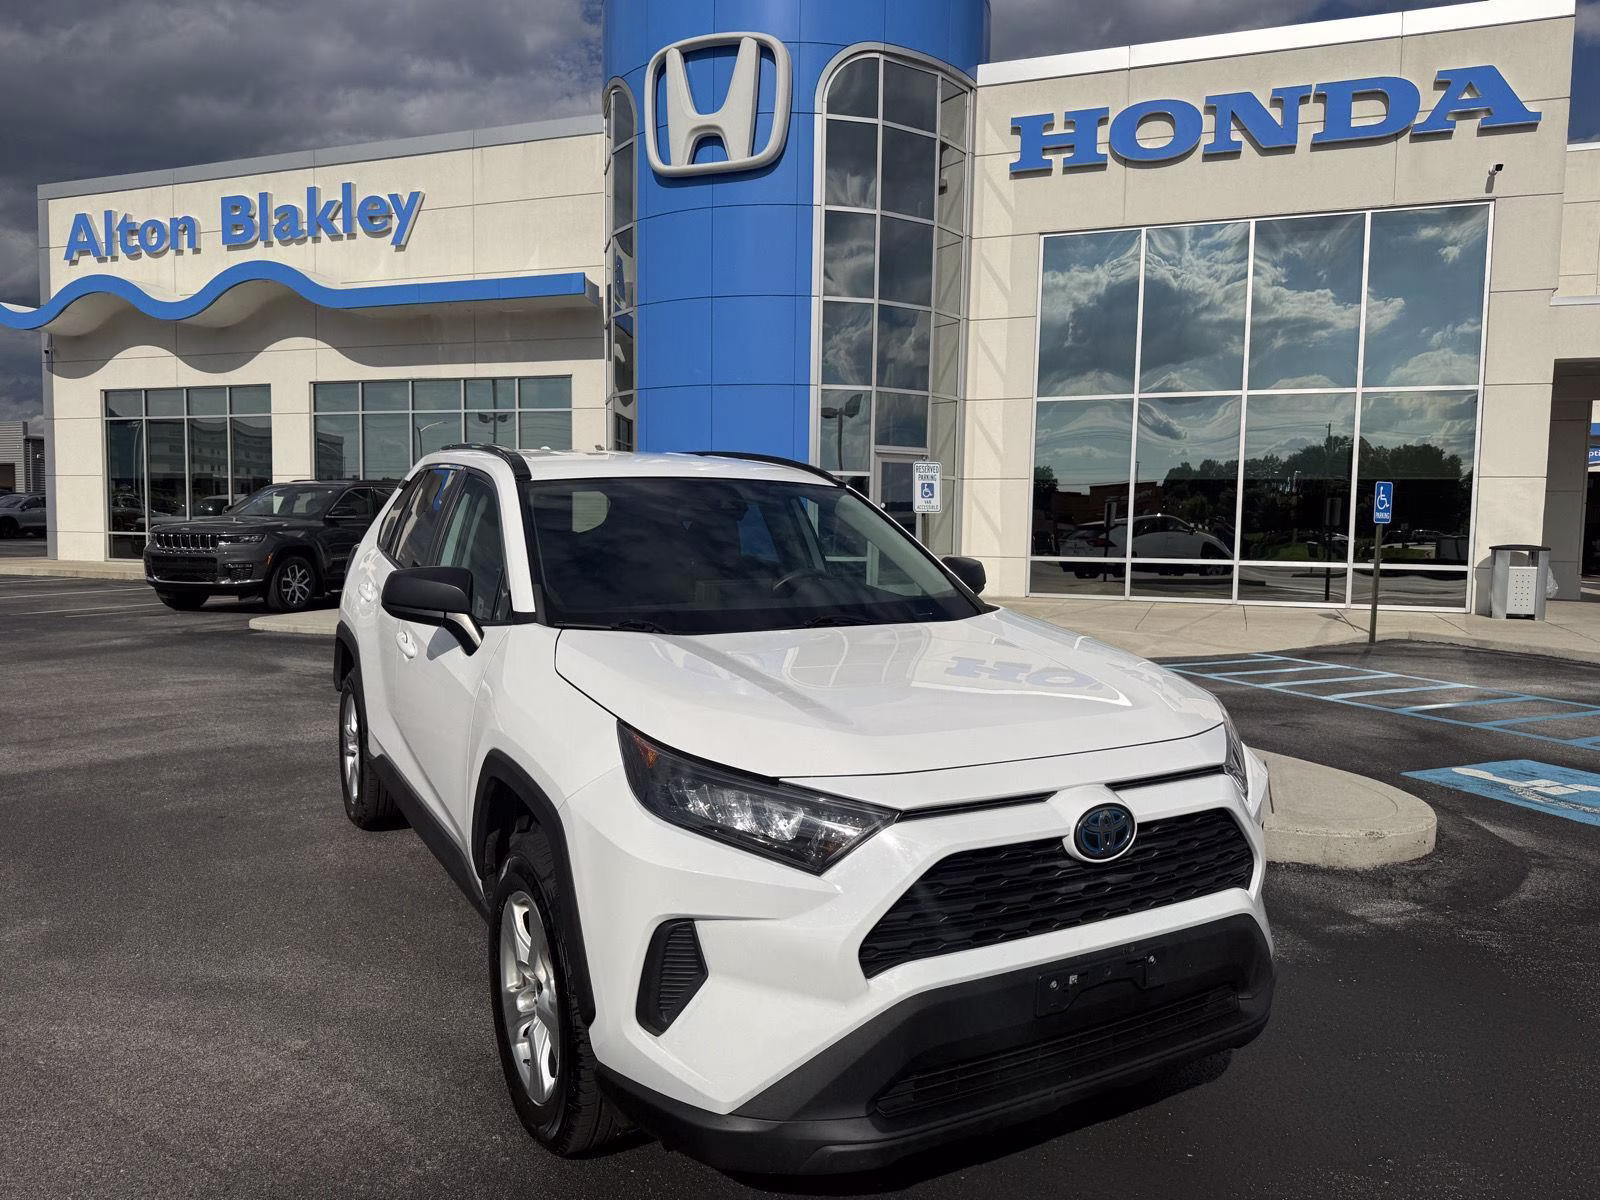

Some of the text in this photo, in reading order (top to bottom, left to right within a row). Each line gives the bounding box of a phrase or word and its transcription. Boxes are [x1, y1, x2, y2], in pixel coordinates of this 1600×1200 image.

[1009, 64, 1542, 174] HONDA
[63, 182, 424, 261] Alton Blakley
